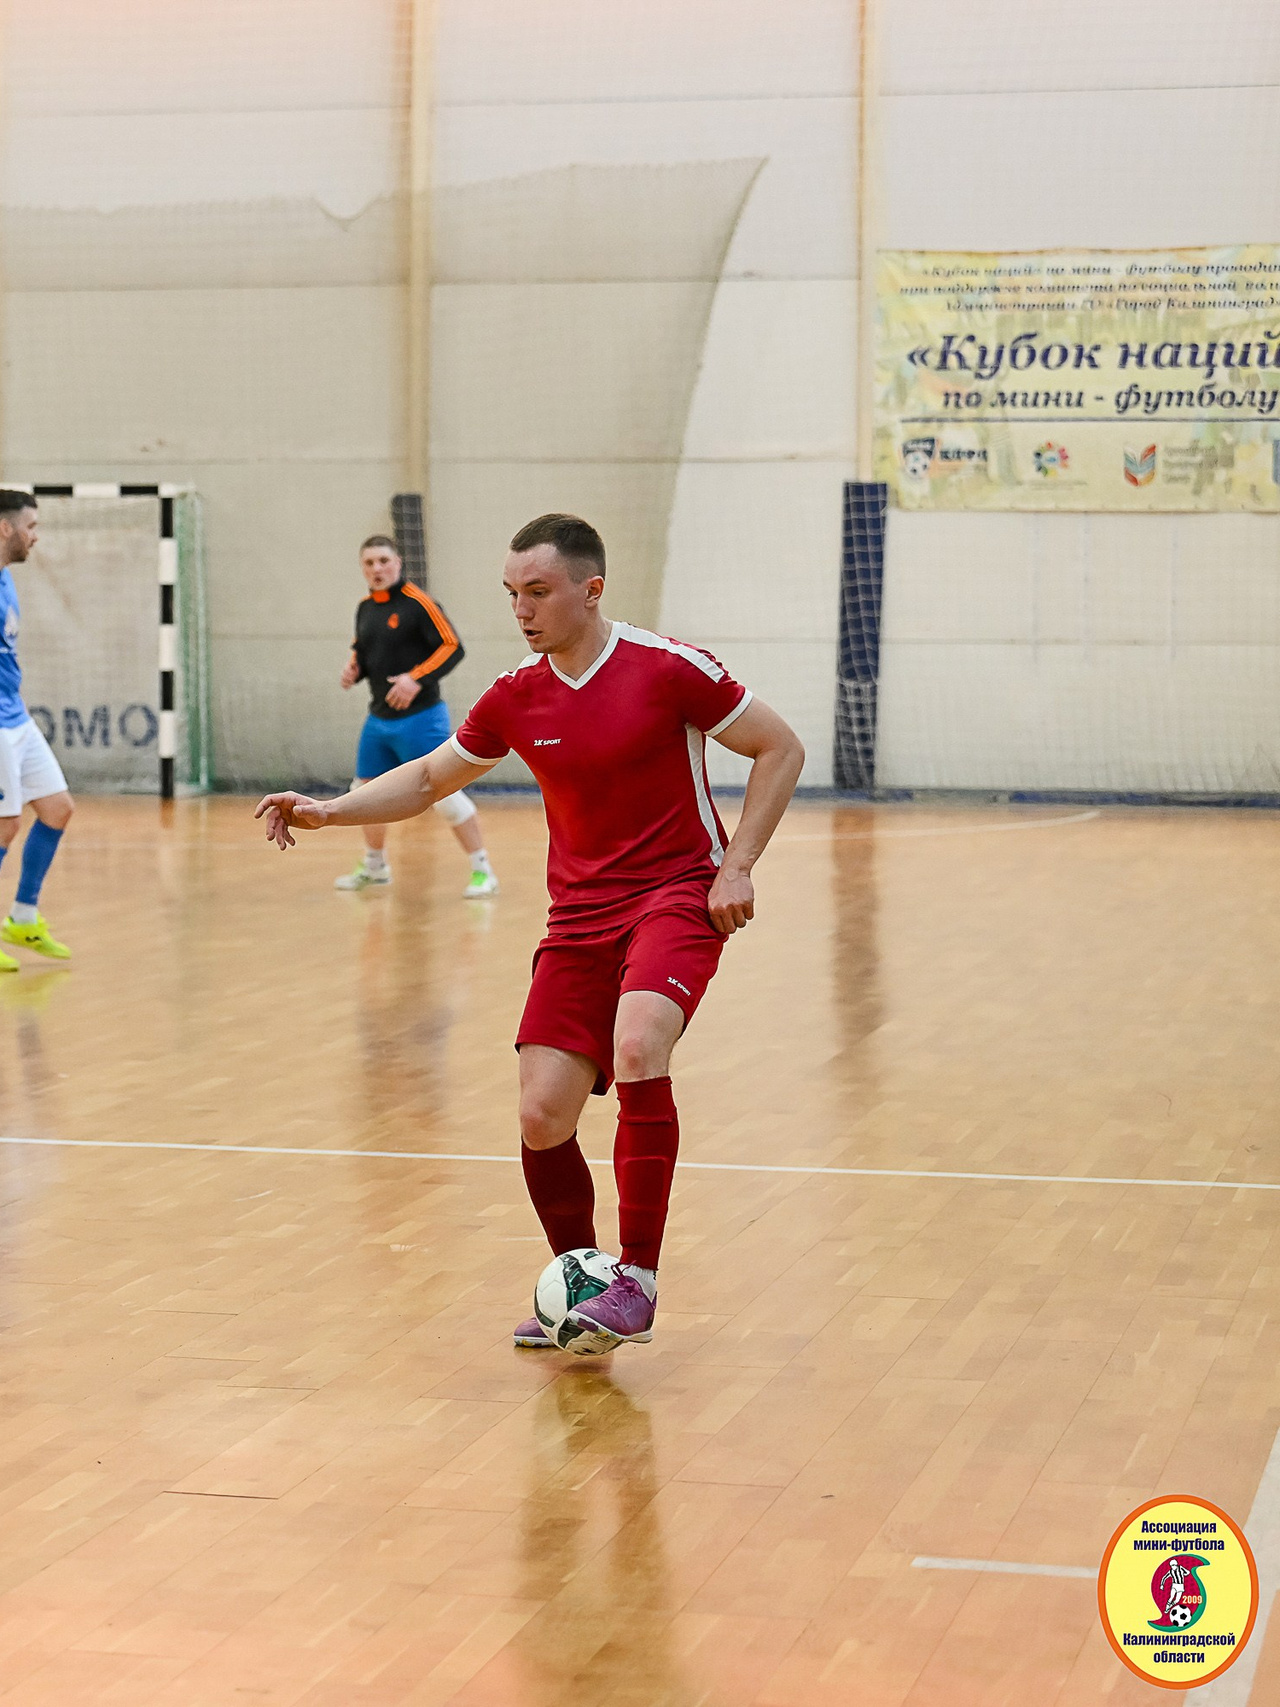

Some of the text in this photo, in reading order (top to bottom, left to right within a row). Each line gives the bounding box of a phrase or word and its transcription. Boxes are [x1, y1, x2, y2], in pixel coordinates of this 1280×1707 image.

[1126, 264, 1202, 278] футболу
[905, 330, 1280, 381] «Кубок наций
[941, 389, 983, 408] по
[989, 388, 1085, 408] мини
[1114, 382, 1279, 415] футболу
